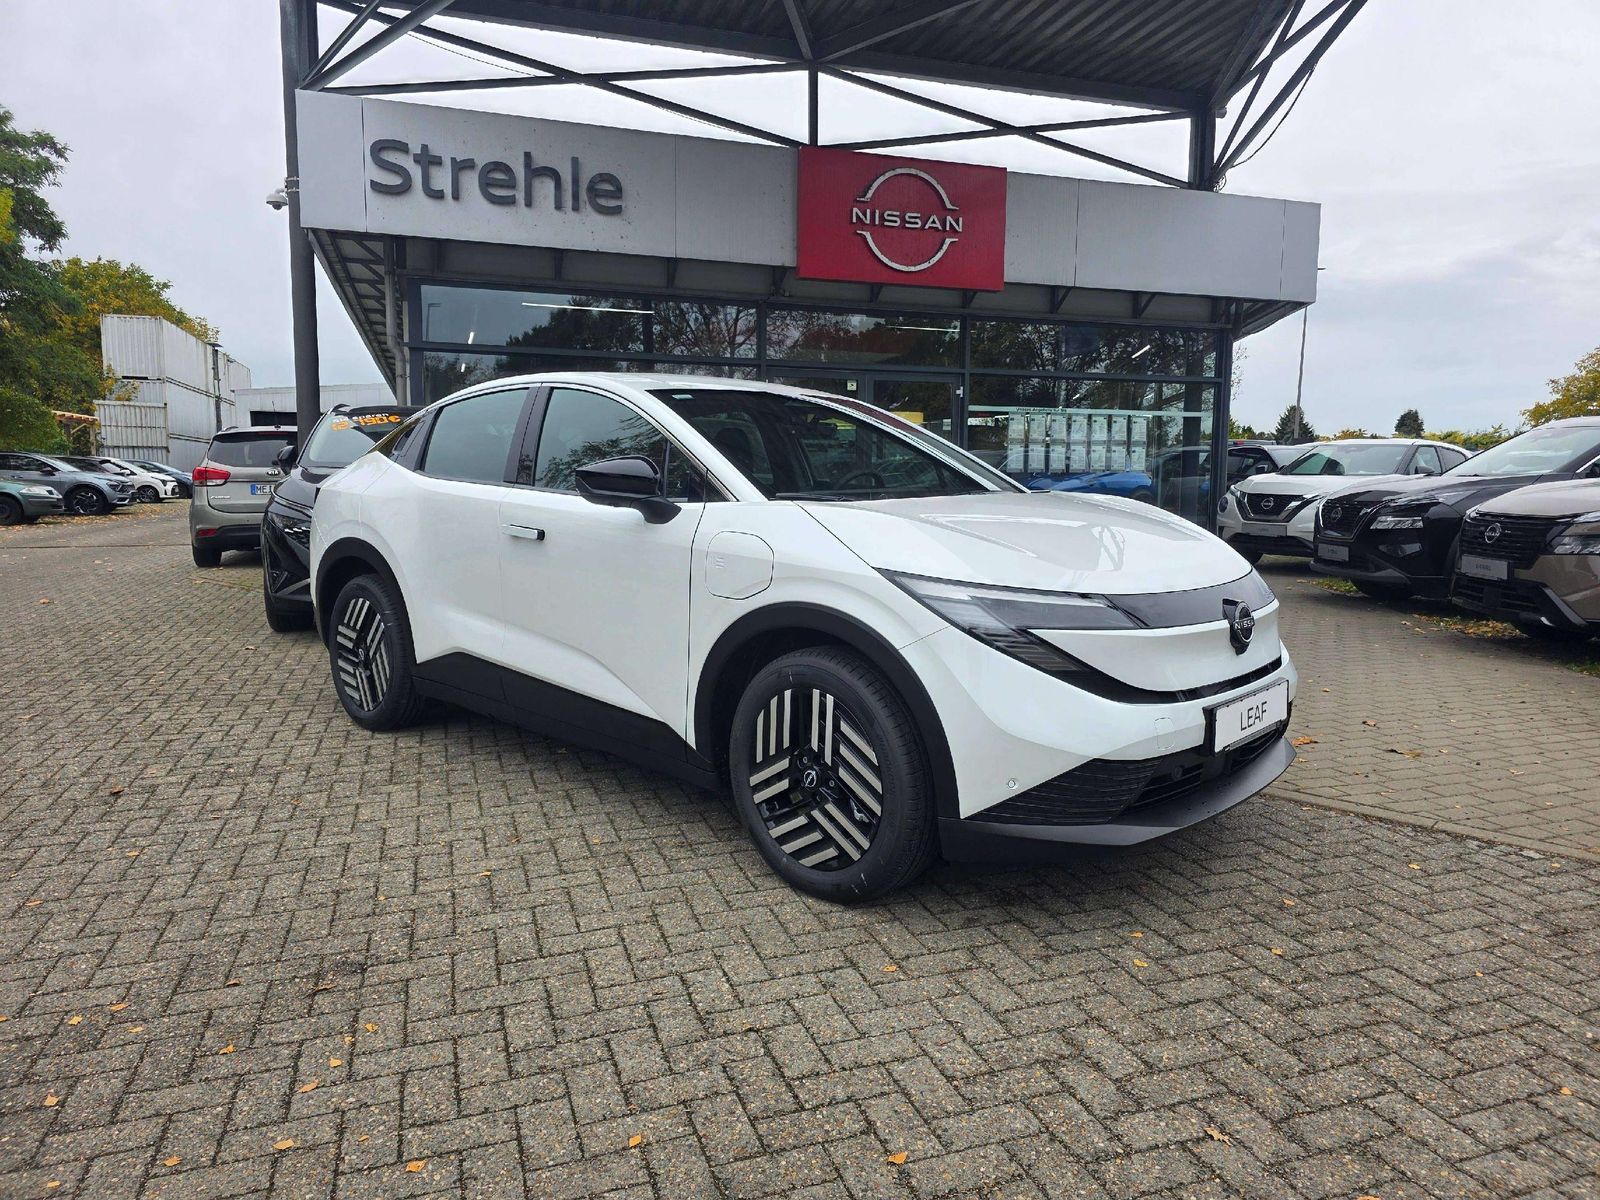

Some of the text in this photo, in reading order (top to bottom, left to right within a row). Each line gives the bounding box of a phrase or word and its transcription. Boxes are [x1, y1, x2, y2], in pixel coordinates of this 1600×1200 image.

[370, 138, 623, 215] Strehle
[852, 207, 963, 232] NISSAN
[1240, 701, 1267, 732] LEAF
